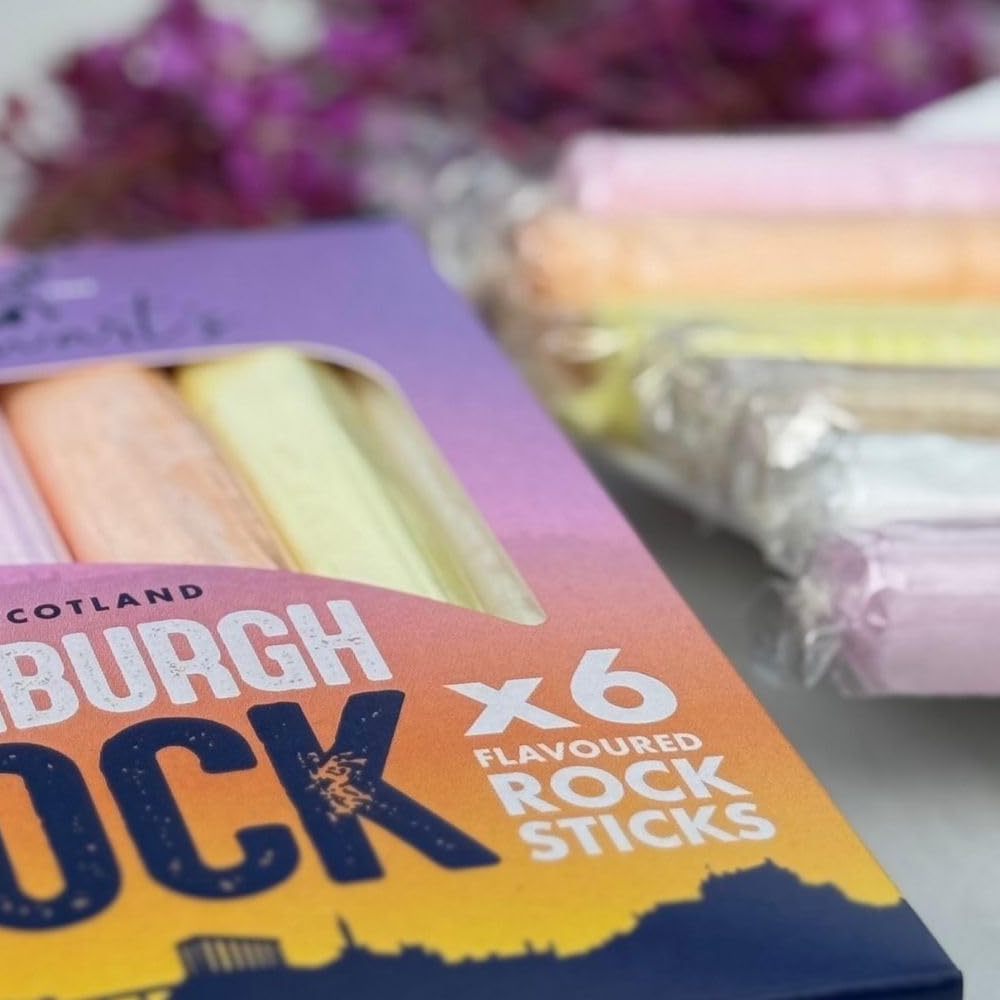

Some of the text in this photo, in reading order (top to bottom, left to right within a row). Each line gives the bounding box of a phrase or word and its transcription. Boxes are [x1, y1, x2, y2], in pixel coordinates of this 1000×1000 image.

[443, 647, 679, 737] x6
[473, 732, 703, 769] FLAVOURED
[487, 755, 753, 817] ROCK
[518, 802, 777, 861] STICKS
